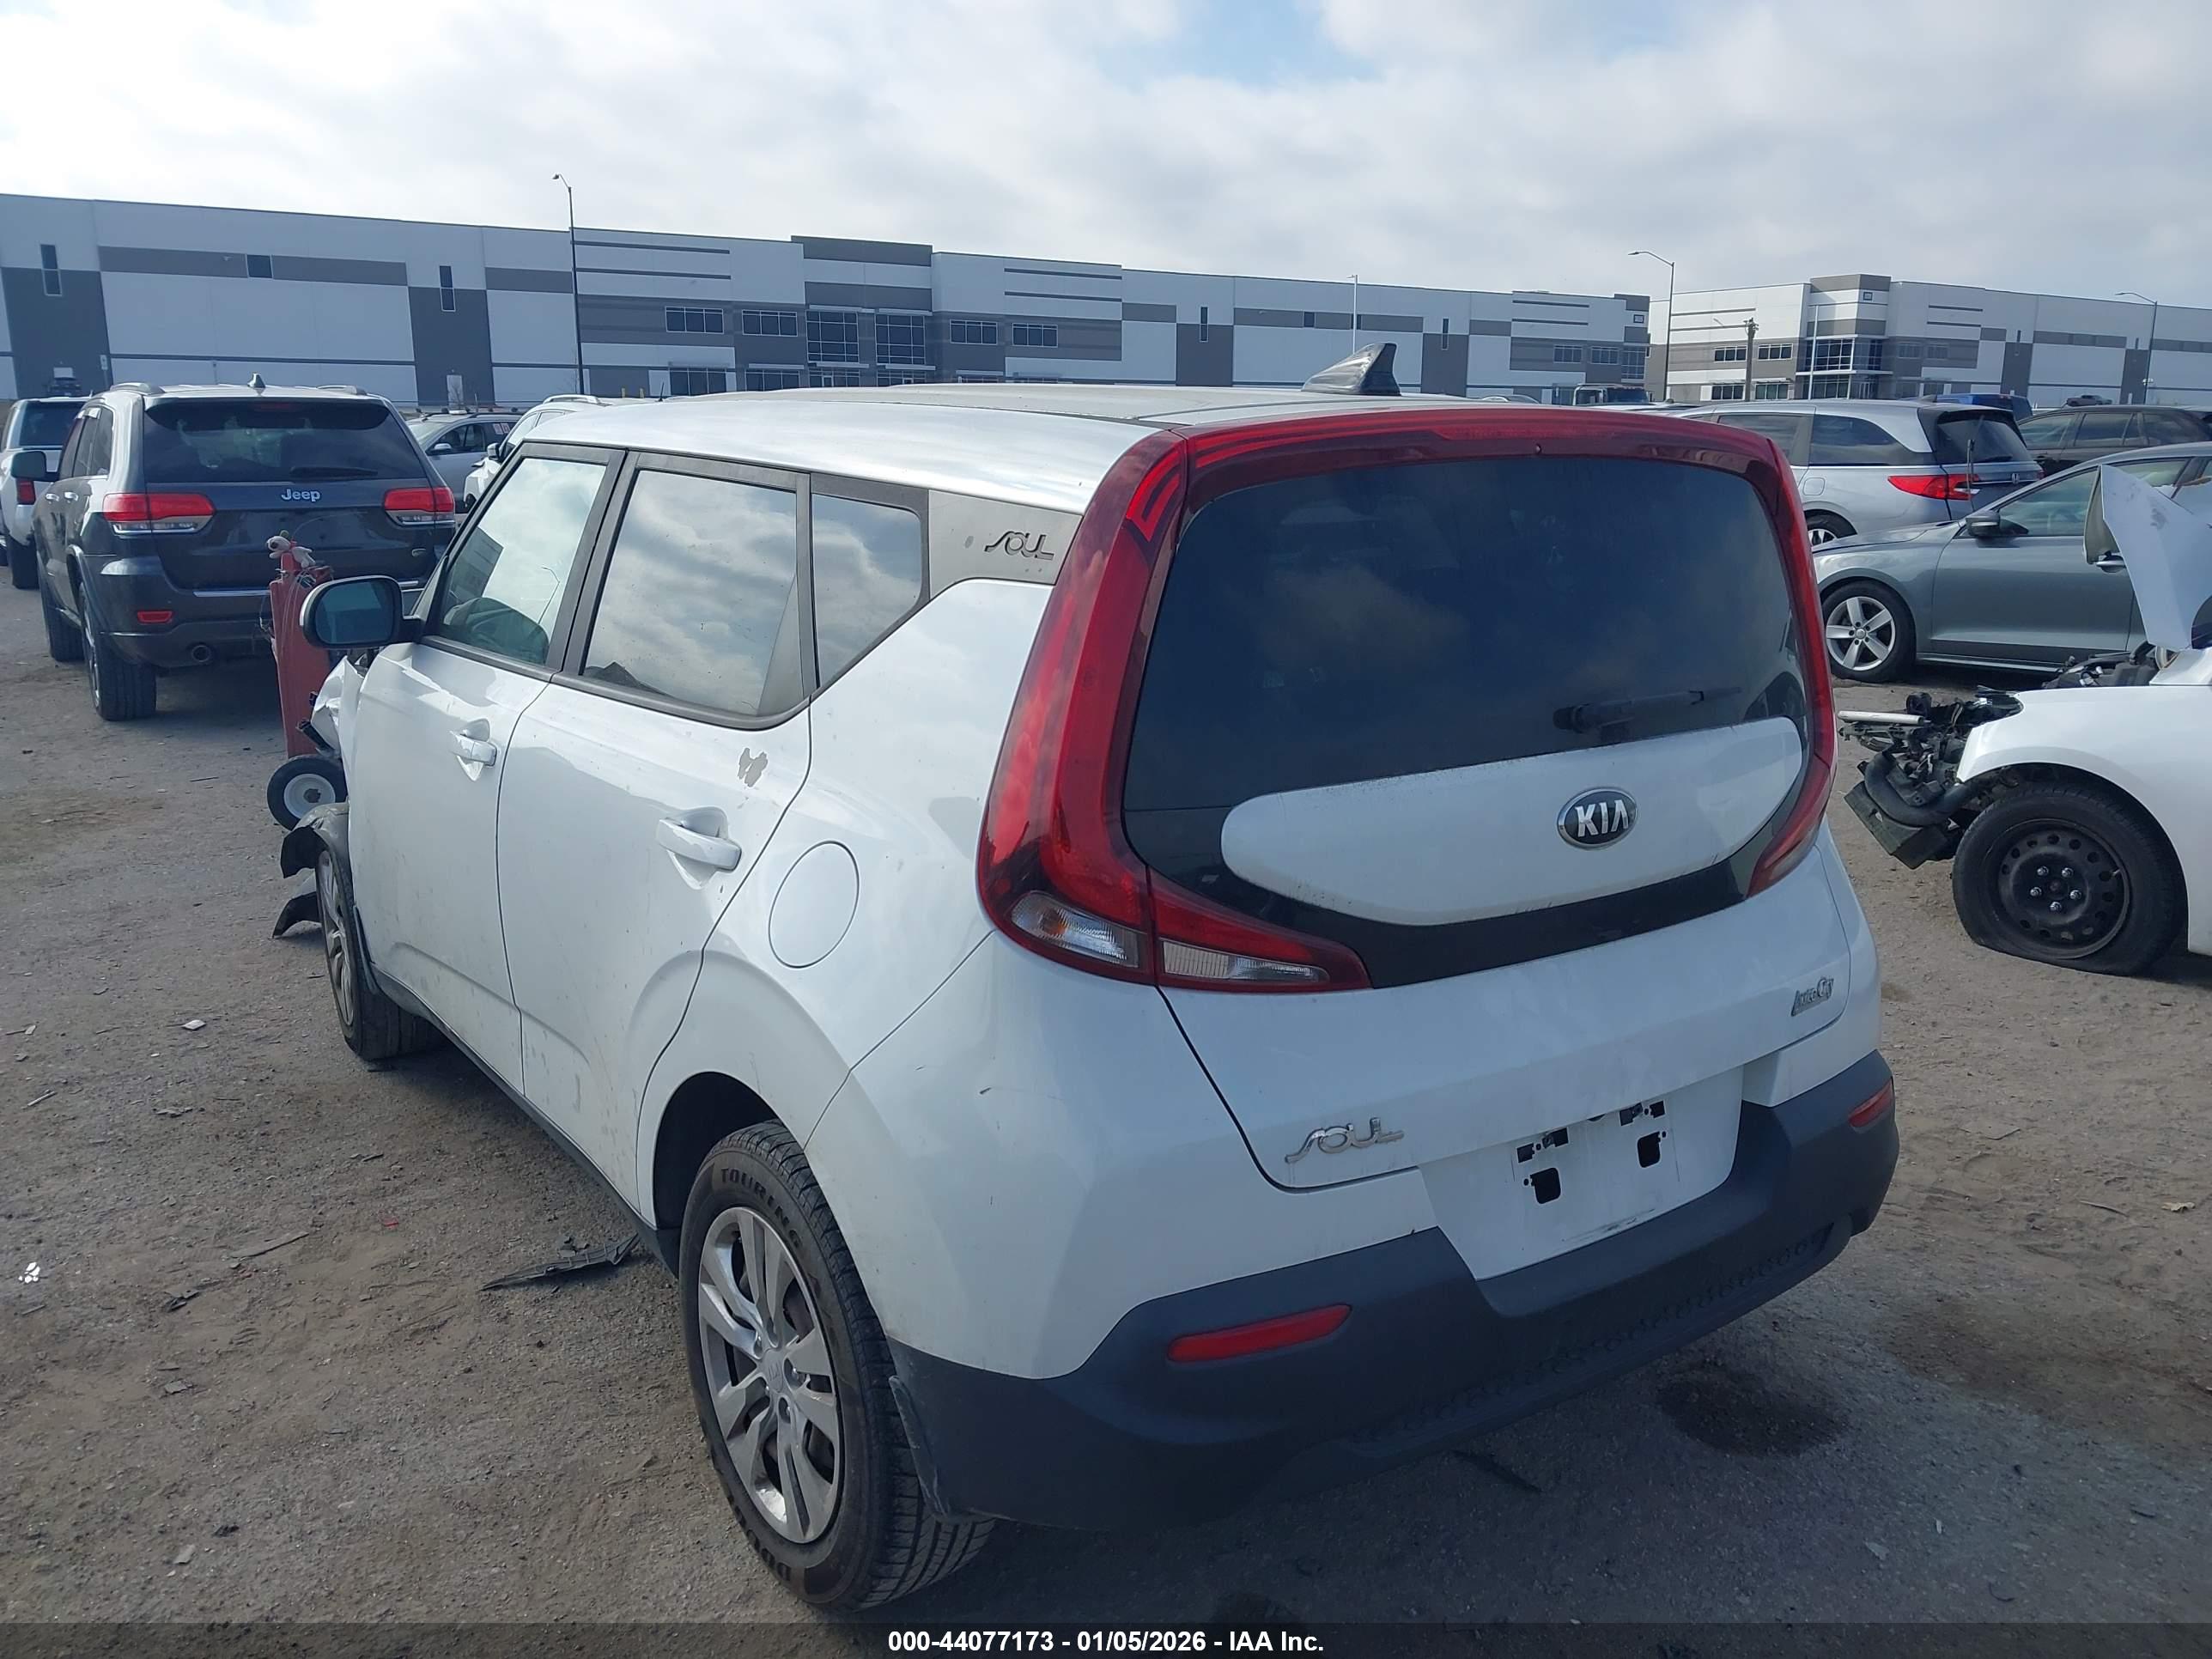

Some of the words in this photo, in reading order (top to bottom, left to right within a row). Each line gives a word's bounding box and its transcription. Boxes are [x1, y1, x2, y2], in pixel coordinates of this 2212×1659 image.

[281, 488, 321, 502] Jeep
[1575, 799, 1629, 838] KIA
[721, 1168, 804, 1249] TOURING
